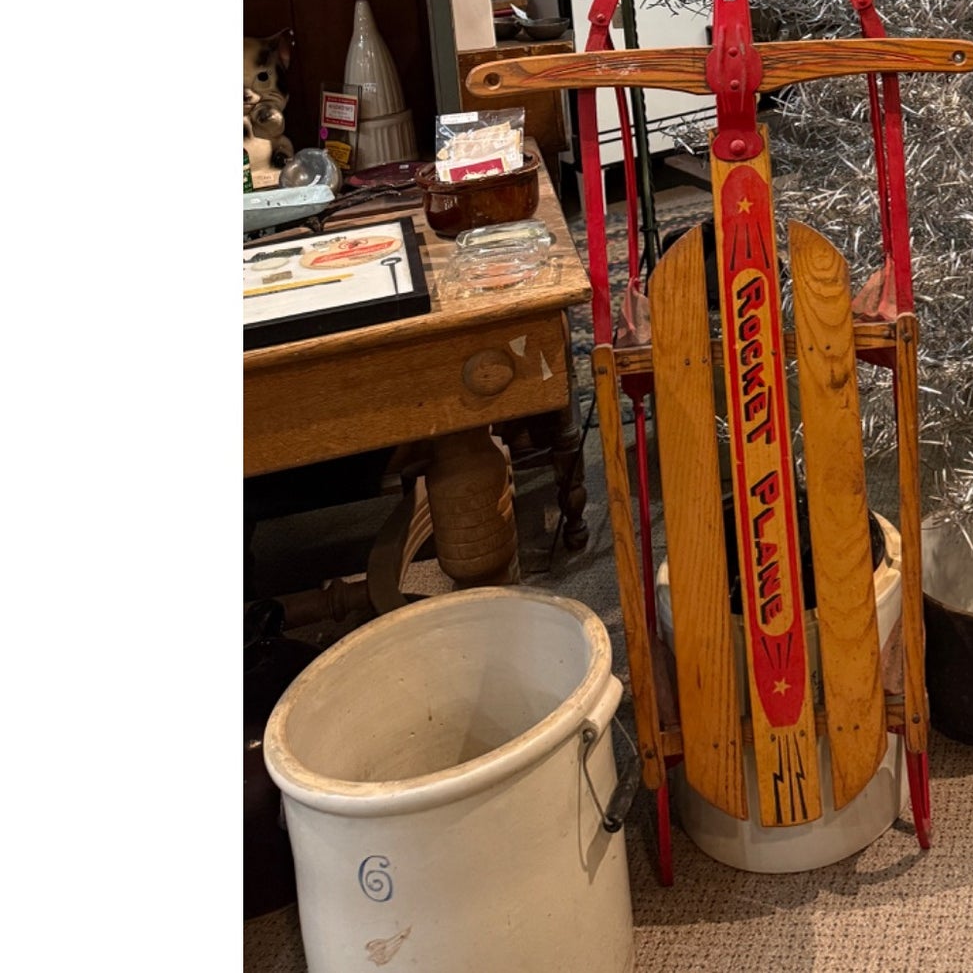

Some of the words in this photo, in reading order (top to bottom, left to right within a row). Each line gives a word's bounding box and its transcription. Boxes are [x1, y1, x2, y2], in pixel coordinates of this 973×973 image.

[736, 275, 777, 445] ROCKET
[750, 469, 784, 626] PLANE
[358, 854, 393, 903] 6
